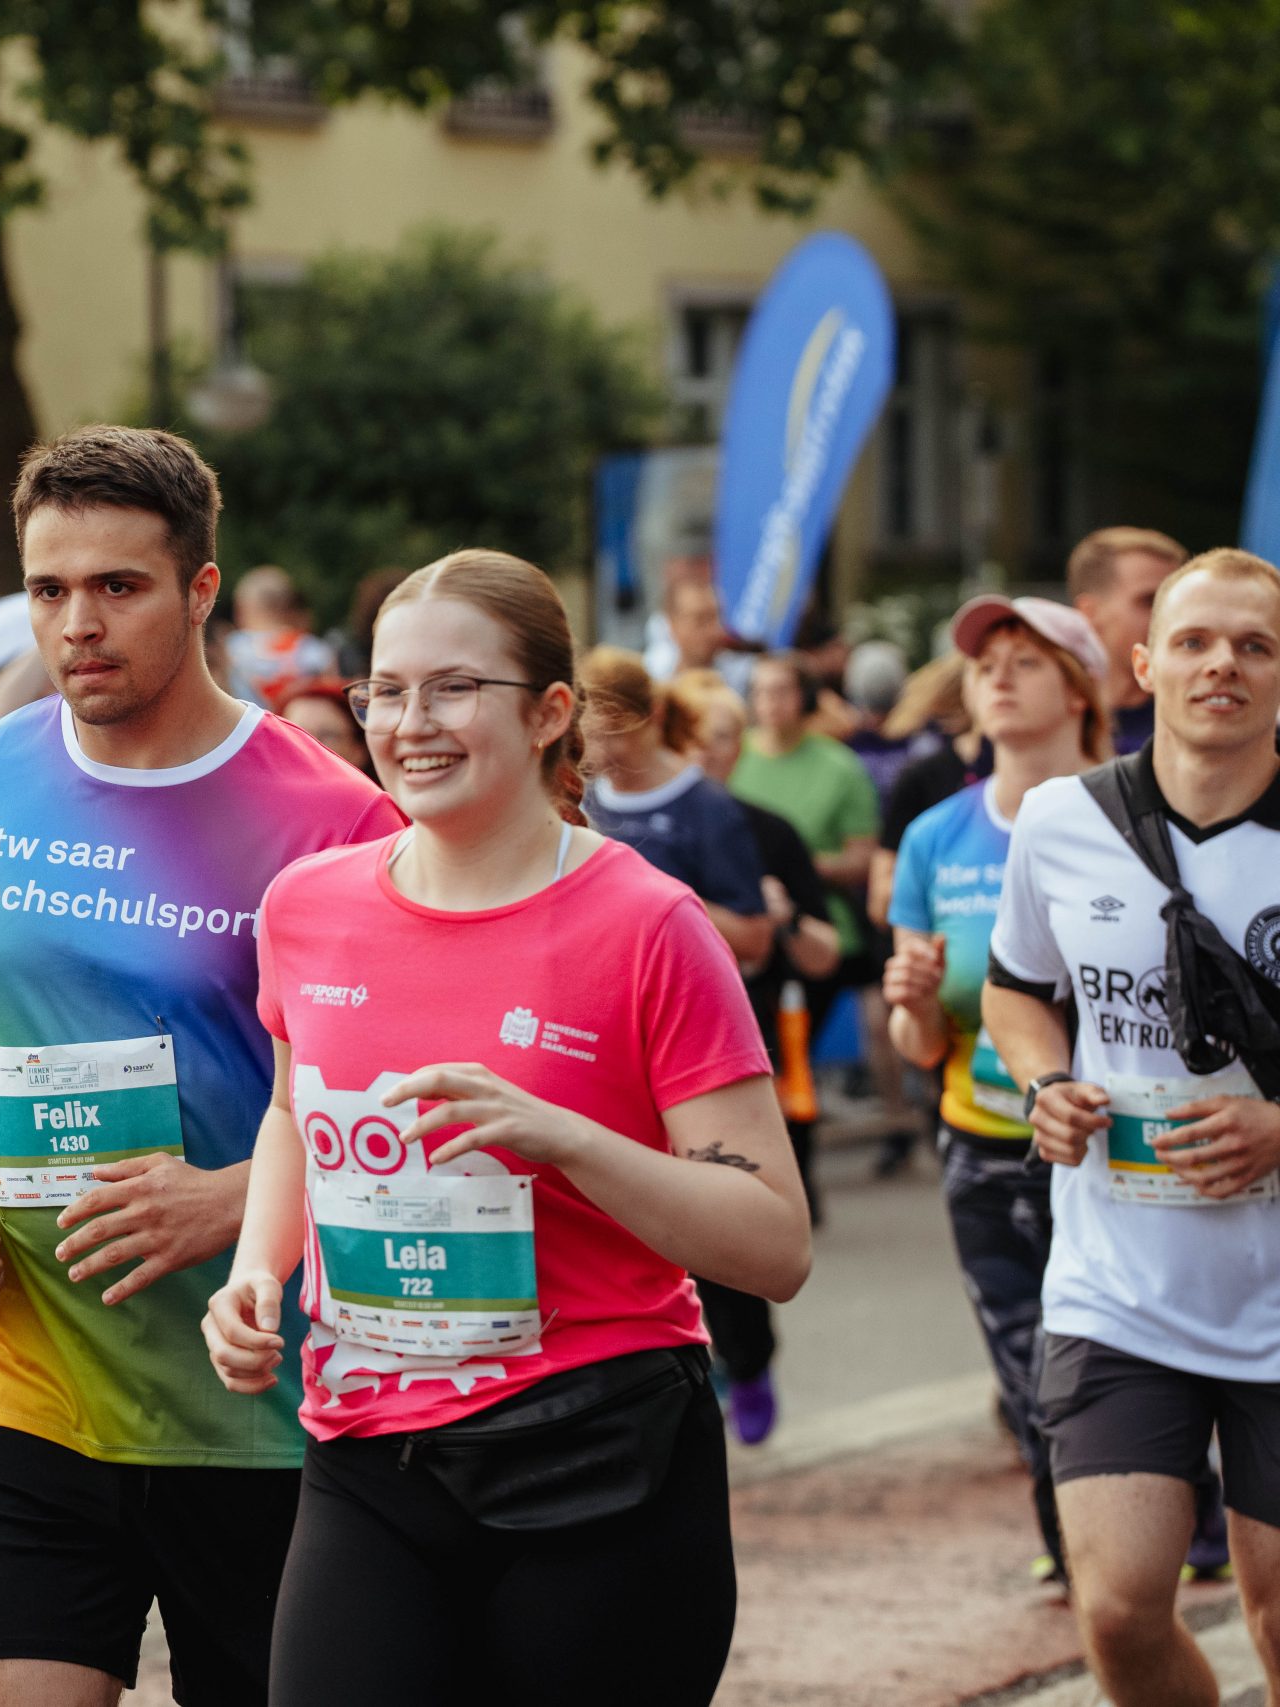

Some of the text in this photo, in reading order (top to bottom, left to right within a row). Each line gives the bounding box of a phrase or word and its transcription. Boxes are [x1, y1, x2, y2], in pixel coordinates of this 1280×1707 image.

[46, 838, 135, 871] saar
[29, 1074, 50, 1085] LAUF
[32, 1100, 101, 1130] Felix
[49, 1134, 90, 1152] 1430
[384, 1238, 447, 1271] Leia
[400, 1277, 433, 1296] 722
